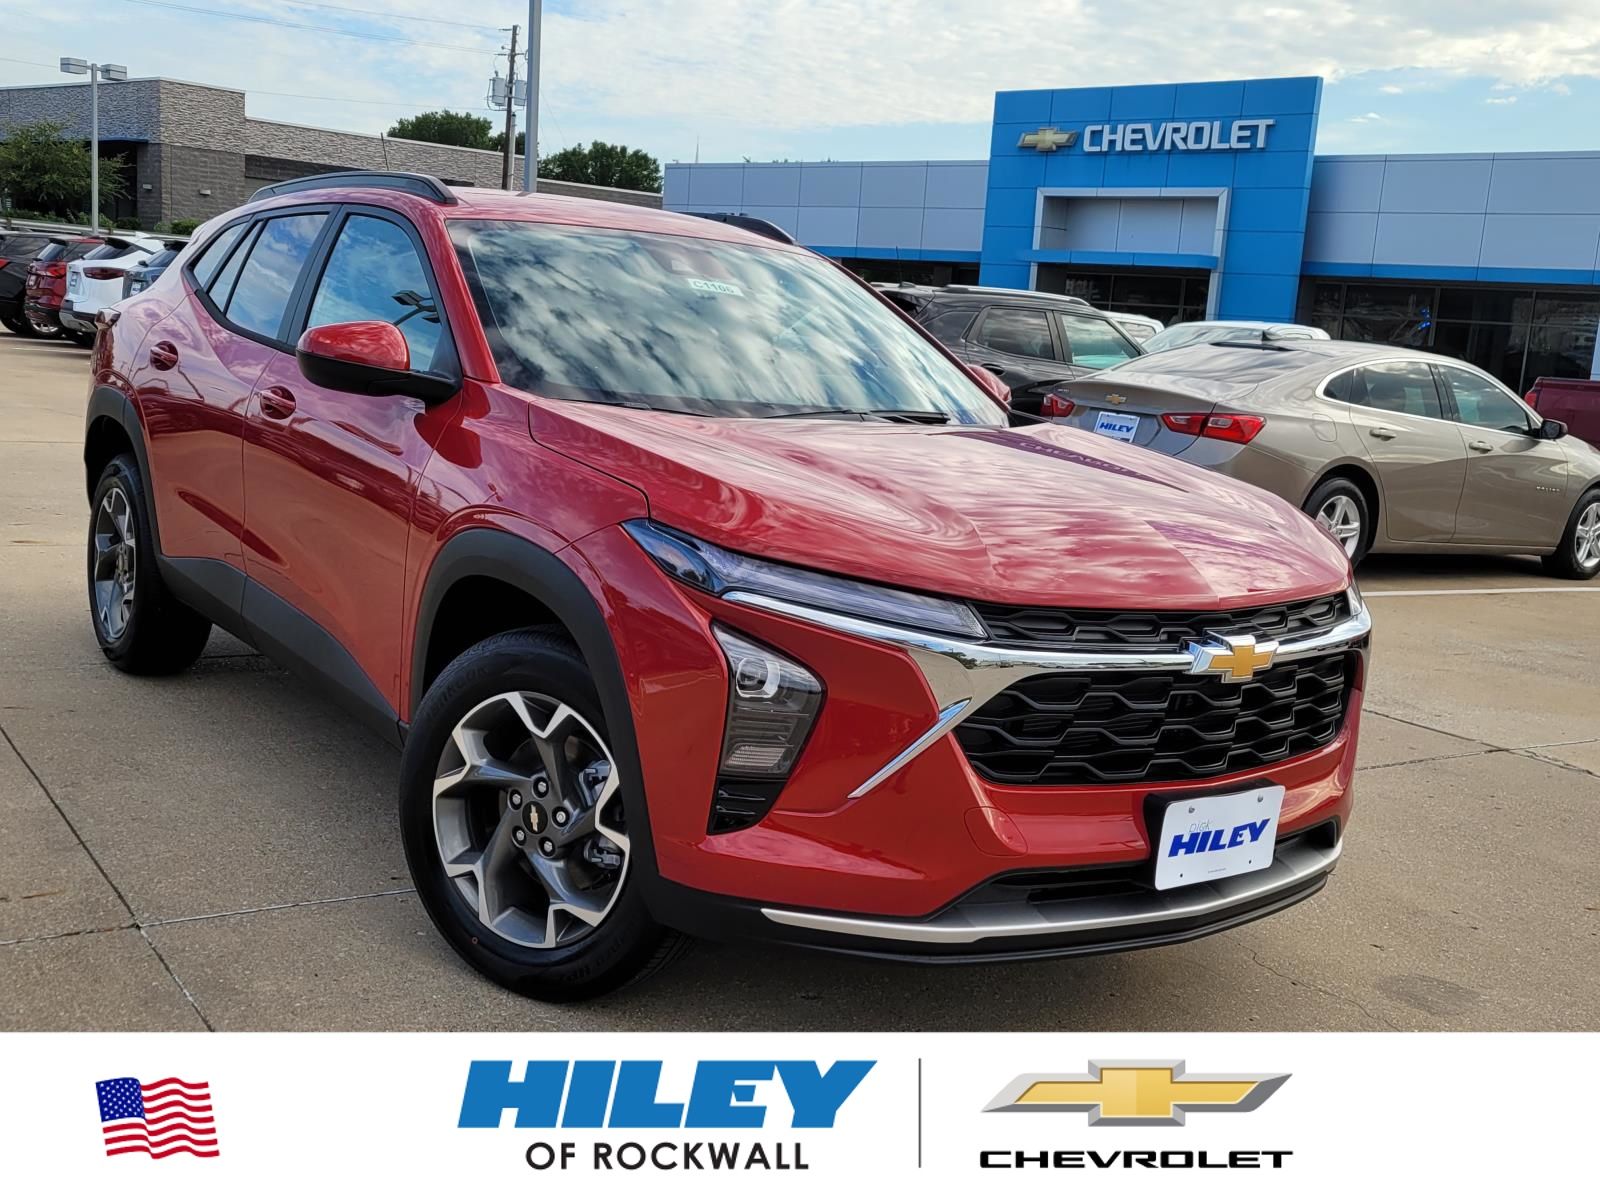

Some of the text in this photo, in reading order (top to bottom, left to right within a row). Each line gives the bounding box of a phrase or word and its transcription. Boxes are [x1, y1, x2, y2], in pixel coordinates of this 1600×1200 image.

[1083, 119, 1276, 152] CHEVROLET
[1100, 422, 1134, 432] HILEY
[1168, 818, 1271, 858] HILEY
